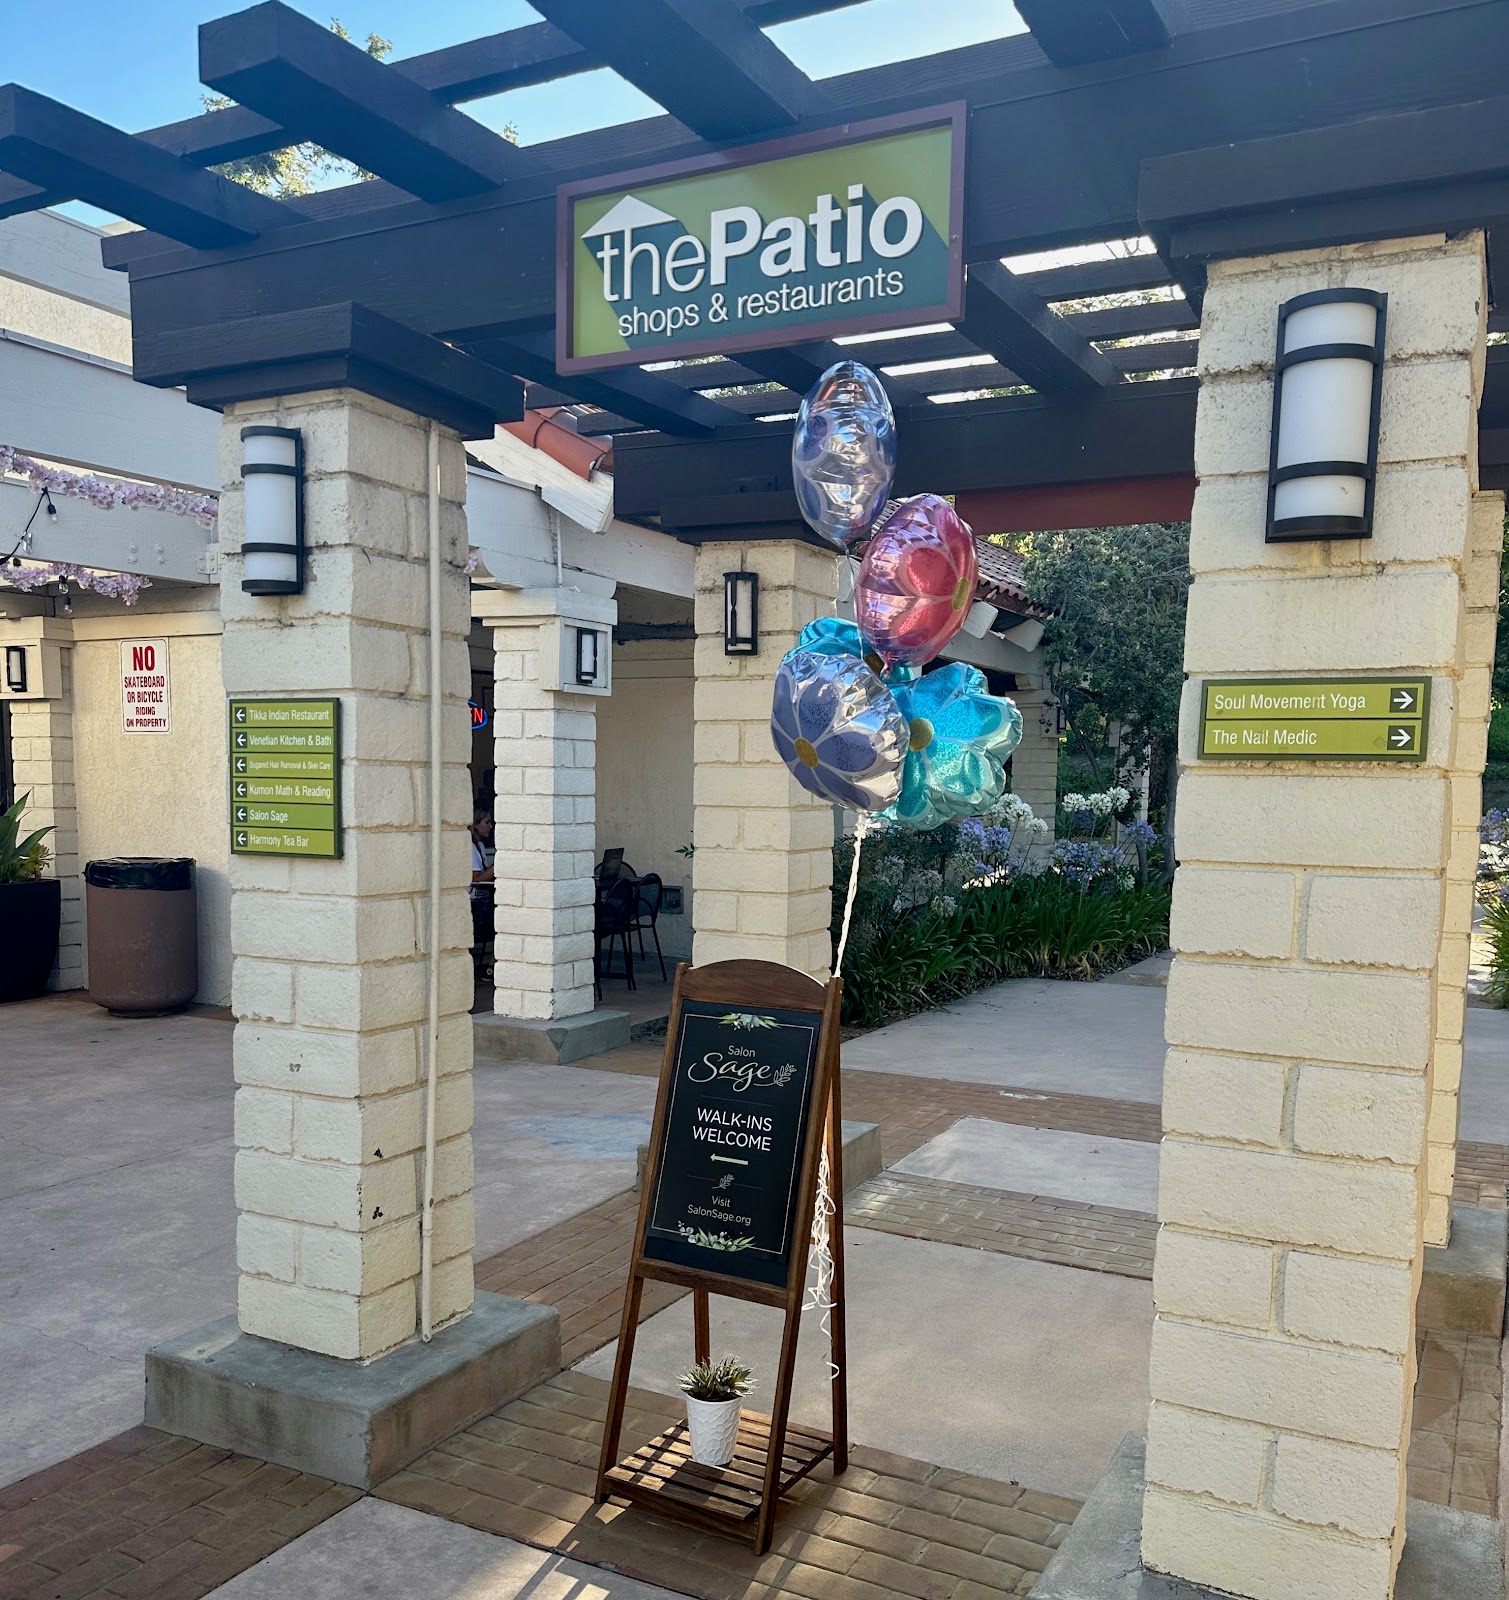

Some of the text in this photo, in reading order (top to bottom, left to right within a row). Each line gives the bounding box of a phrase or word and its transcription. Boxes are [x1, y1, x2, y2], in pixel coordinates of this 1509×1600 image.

[618, 267, 904, 337] shops & restaurants
[133, 646, 155, 671] NO
[124, 676, 164, 688] SKATEBOARD
[127, 691, 163, 703] OR BICYCLE
[1214, 694, 1366, 712] Soul Movement Yoga
[136, 706, 156, 716] RIDING
[250, 710, 330, 720] Tikka Indian Restaurant
[126, 718, 166, 728] ON PROPERTY
[250, 736, 332, 746] Venetian Kitchen & Bath
[1212, 728, 1317, 744] The Nail Medic
[280, 761, 301, 769] Removal
[320, 762, 330, 770] Care
[250, 784, 330, 799] Kumon Math & Reading
[250, 810, 288, 824] Salon Sage
[250, 834, 308, 848] Harmony Tea Bar
[727, 1045, 756, 1058] Salon
[688, 1052, 772, 1092] Sage
[697, 1108, 772, 1132] WALK-INS
[692, 1126, 772, 1152] WELCOME
[711, 1195, 731, 1208] Visit
[687, 1204, 752, 1226] SalonSage.org
